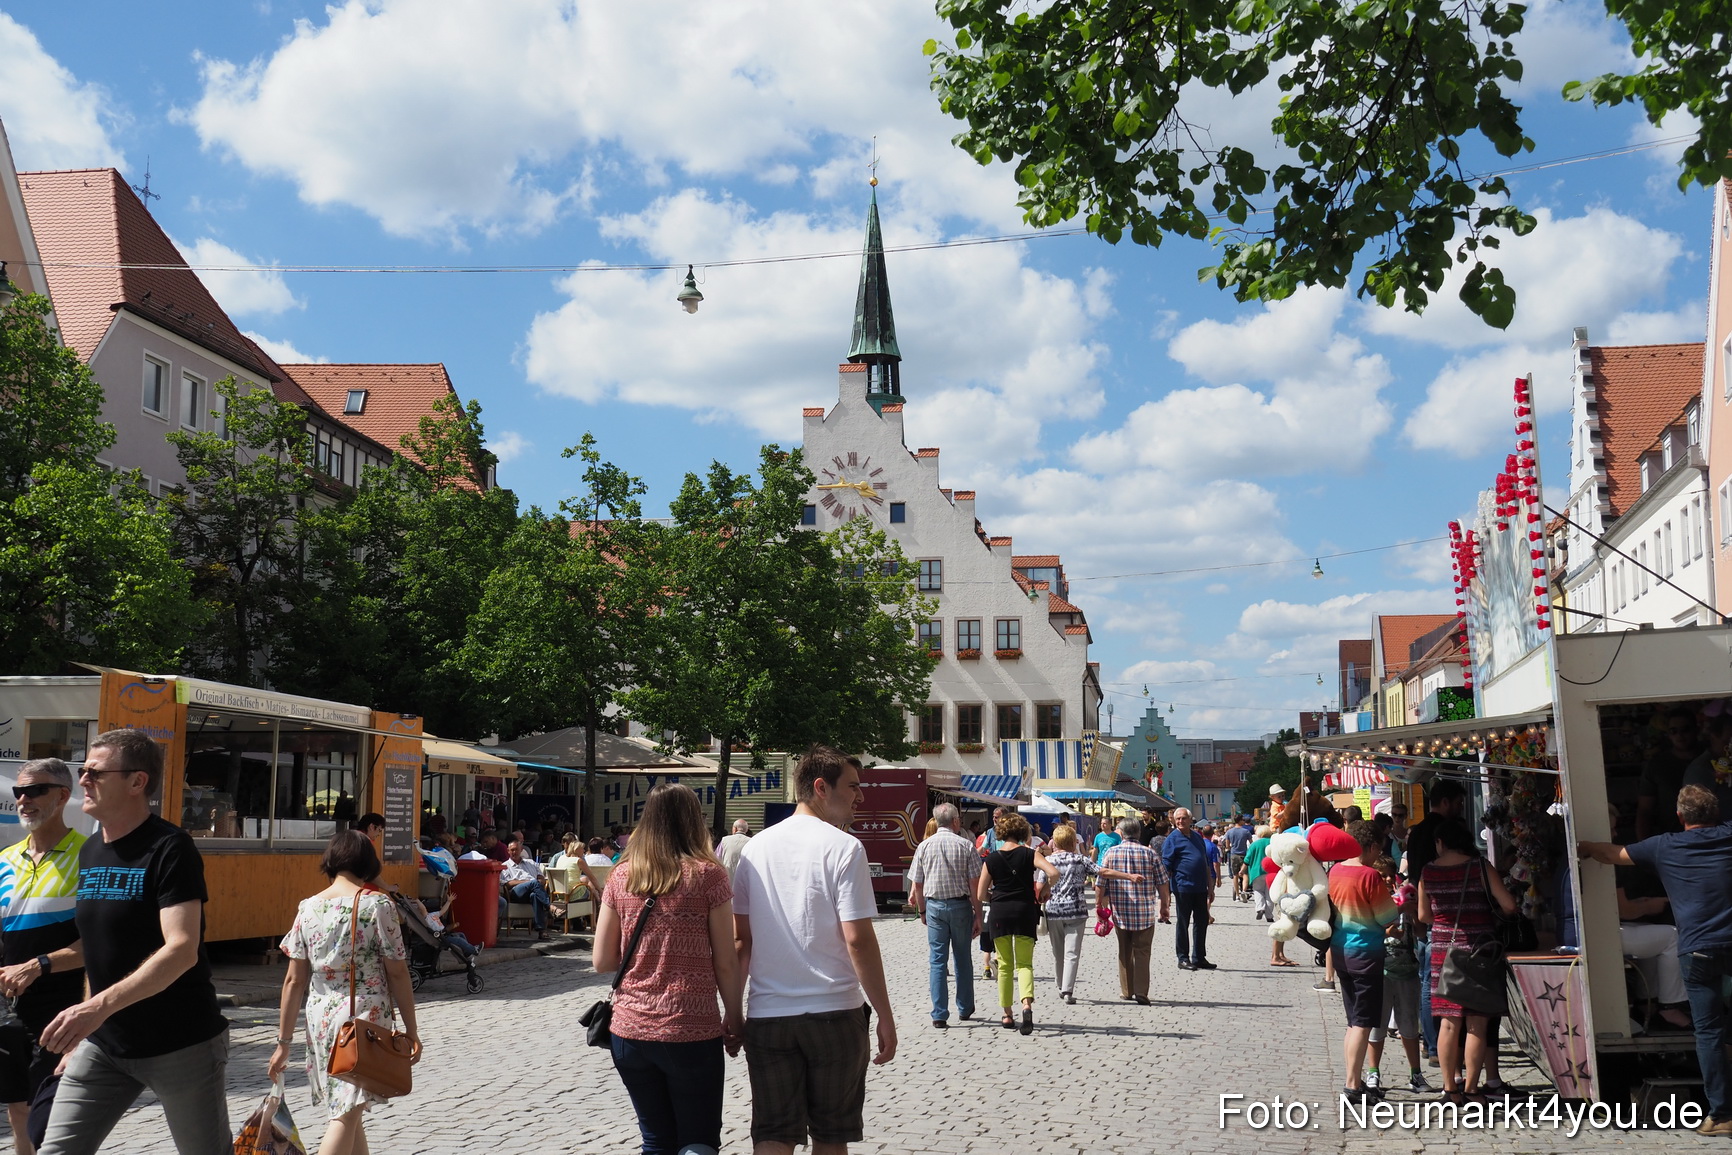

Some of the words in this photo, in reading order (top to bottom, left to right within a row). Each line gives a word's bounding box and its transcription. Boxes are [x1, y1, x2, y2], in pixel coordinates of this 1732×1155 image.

[195, 688, 226, 704] Original
[227, 694, 260, 710] Backfisch
[266, 700, 290, 715] Matjes-
[290, 704, 321, 719] Bismarck-
[322, 709, 359, 724] Lachssemmel
